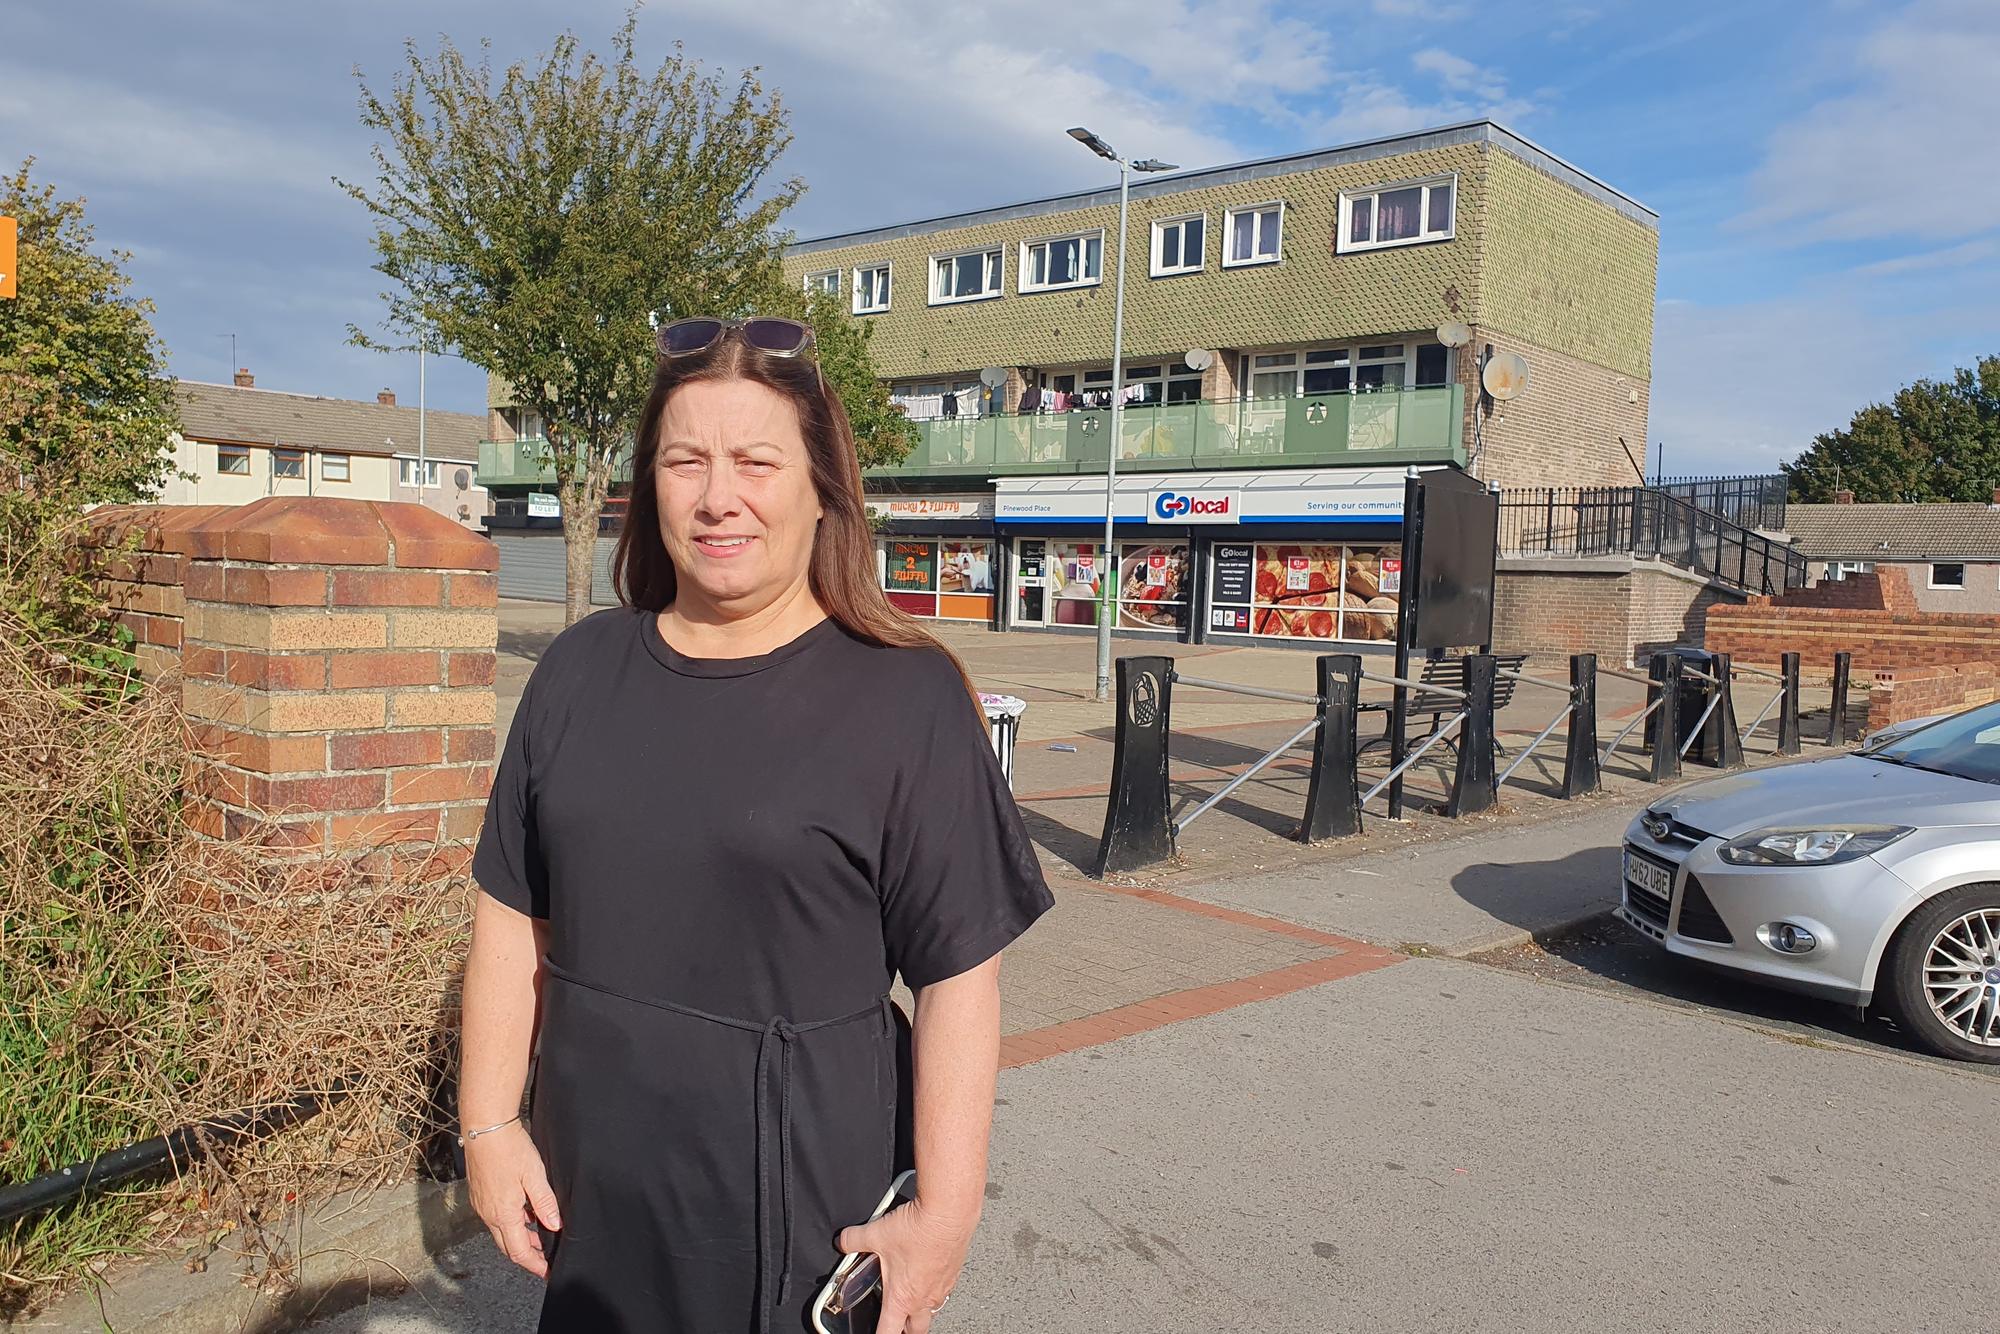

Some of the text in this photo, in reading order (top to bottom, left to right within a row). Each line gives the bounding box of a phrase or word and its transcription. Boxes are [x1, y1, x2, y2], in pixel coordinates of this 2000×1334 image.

[920, 500, 928, 513] 2
[1307, 502, 1339, 510] Serving
[906, 556, 916, 569] 2
[1650, 867, 1668, 896] UBE
